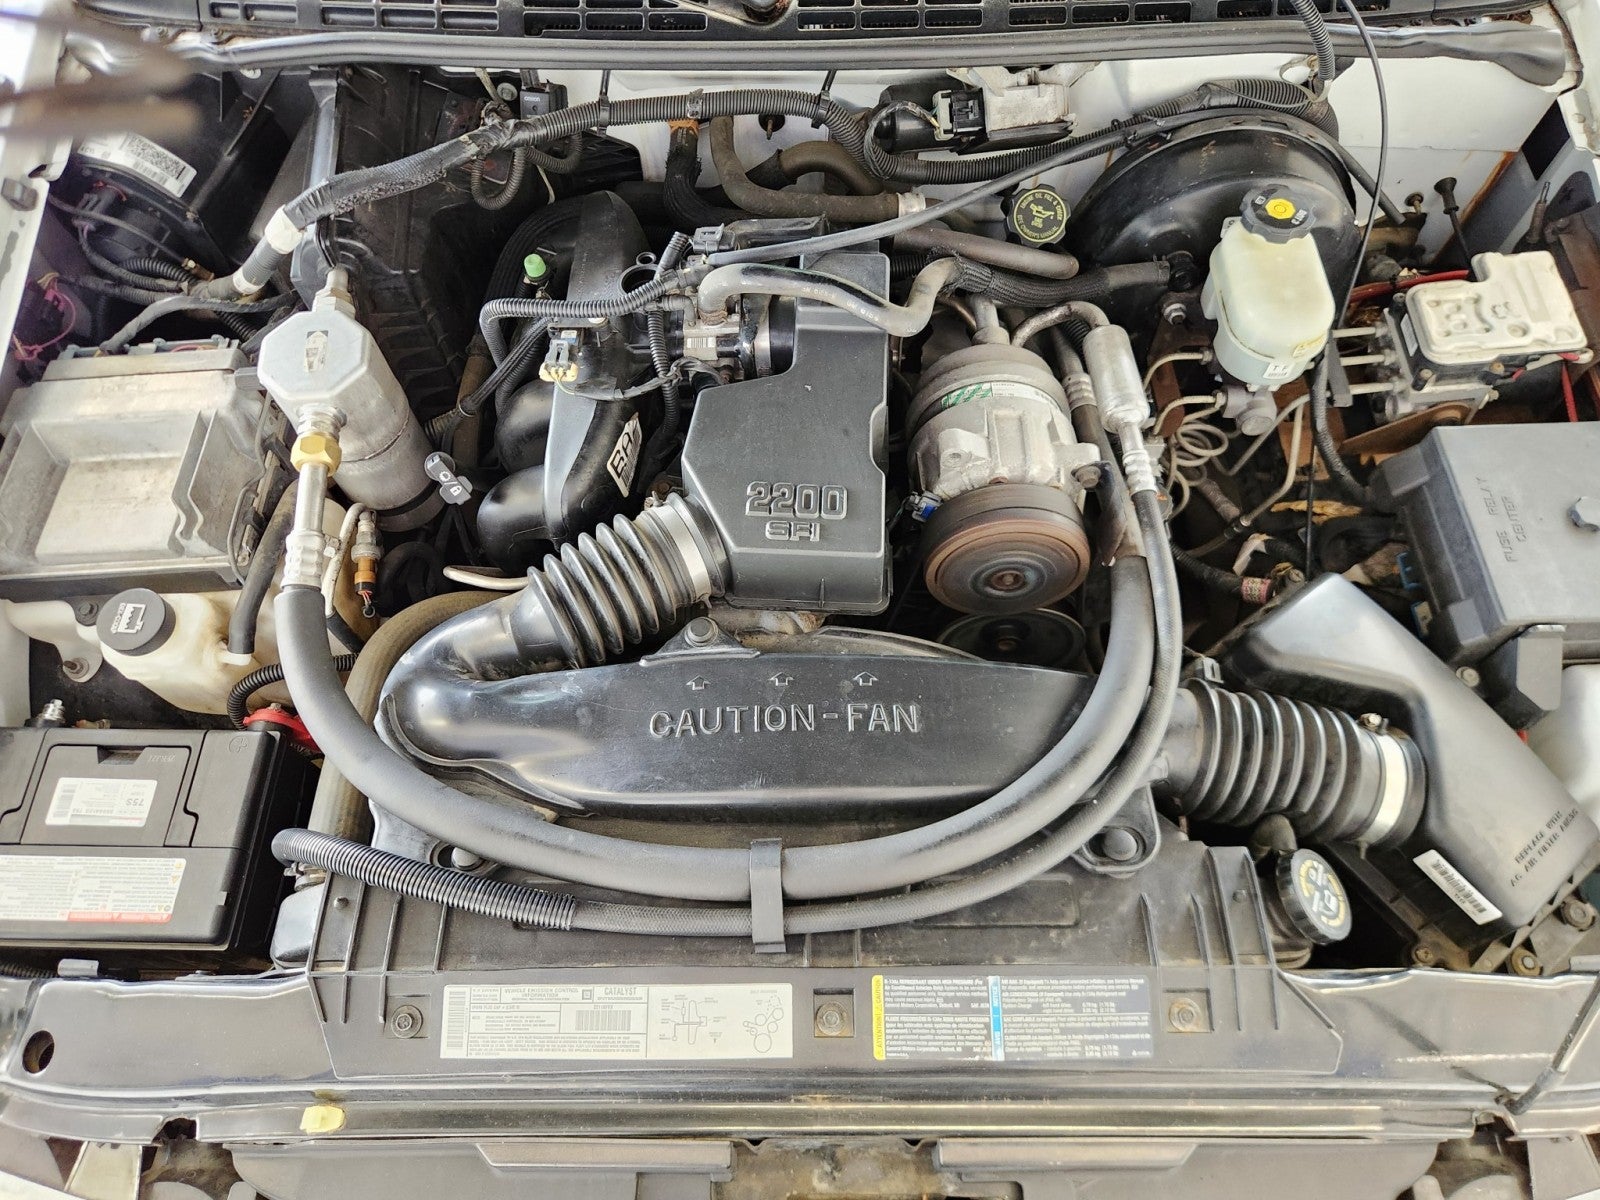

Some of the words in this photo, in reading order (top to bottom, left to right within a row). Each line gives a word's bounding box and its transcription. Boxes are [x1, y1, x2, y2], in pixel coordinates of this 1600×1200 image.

[745, 481, 848, 520] 2200
[1476, 477, 1498, 516] RELAY
[765, 520, 821, 542] SFI
[1501, 496, 1527, 541] CENTER
[1496, 530, 1518, 562] FUSE
[650, 702, 815, 739] CAUTION
[847, 703, 921, 732] FAN
[1515, 831, 1544, 864] REPLACE
[1524, 857, 1538, 872] AIR
[1538, 832, 1560, 857] FILTER
[604, 987, 637, 996] CATALYST
